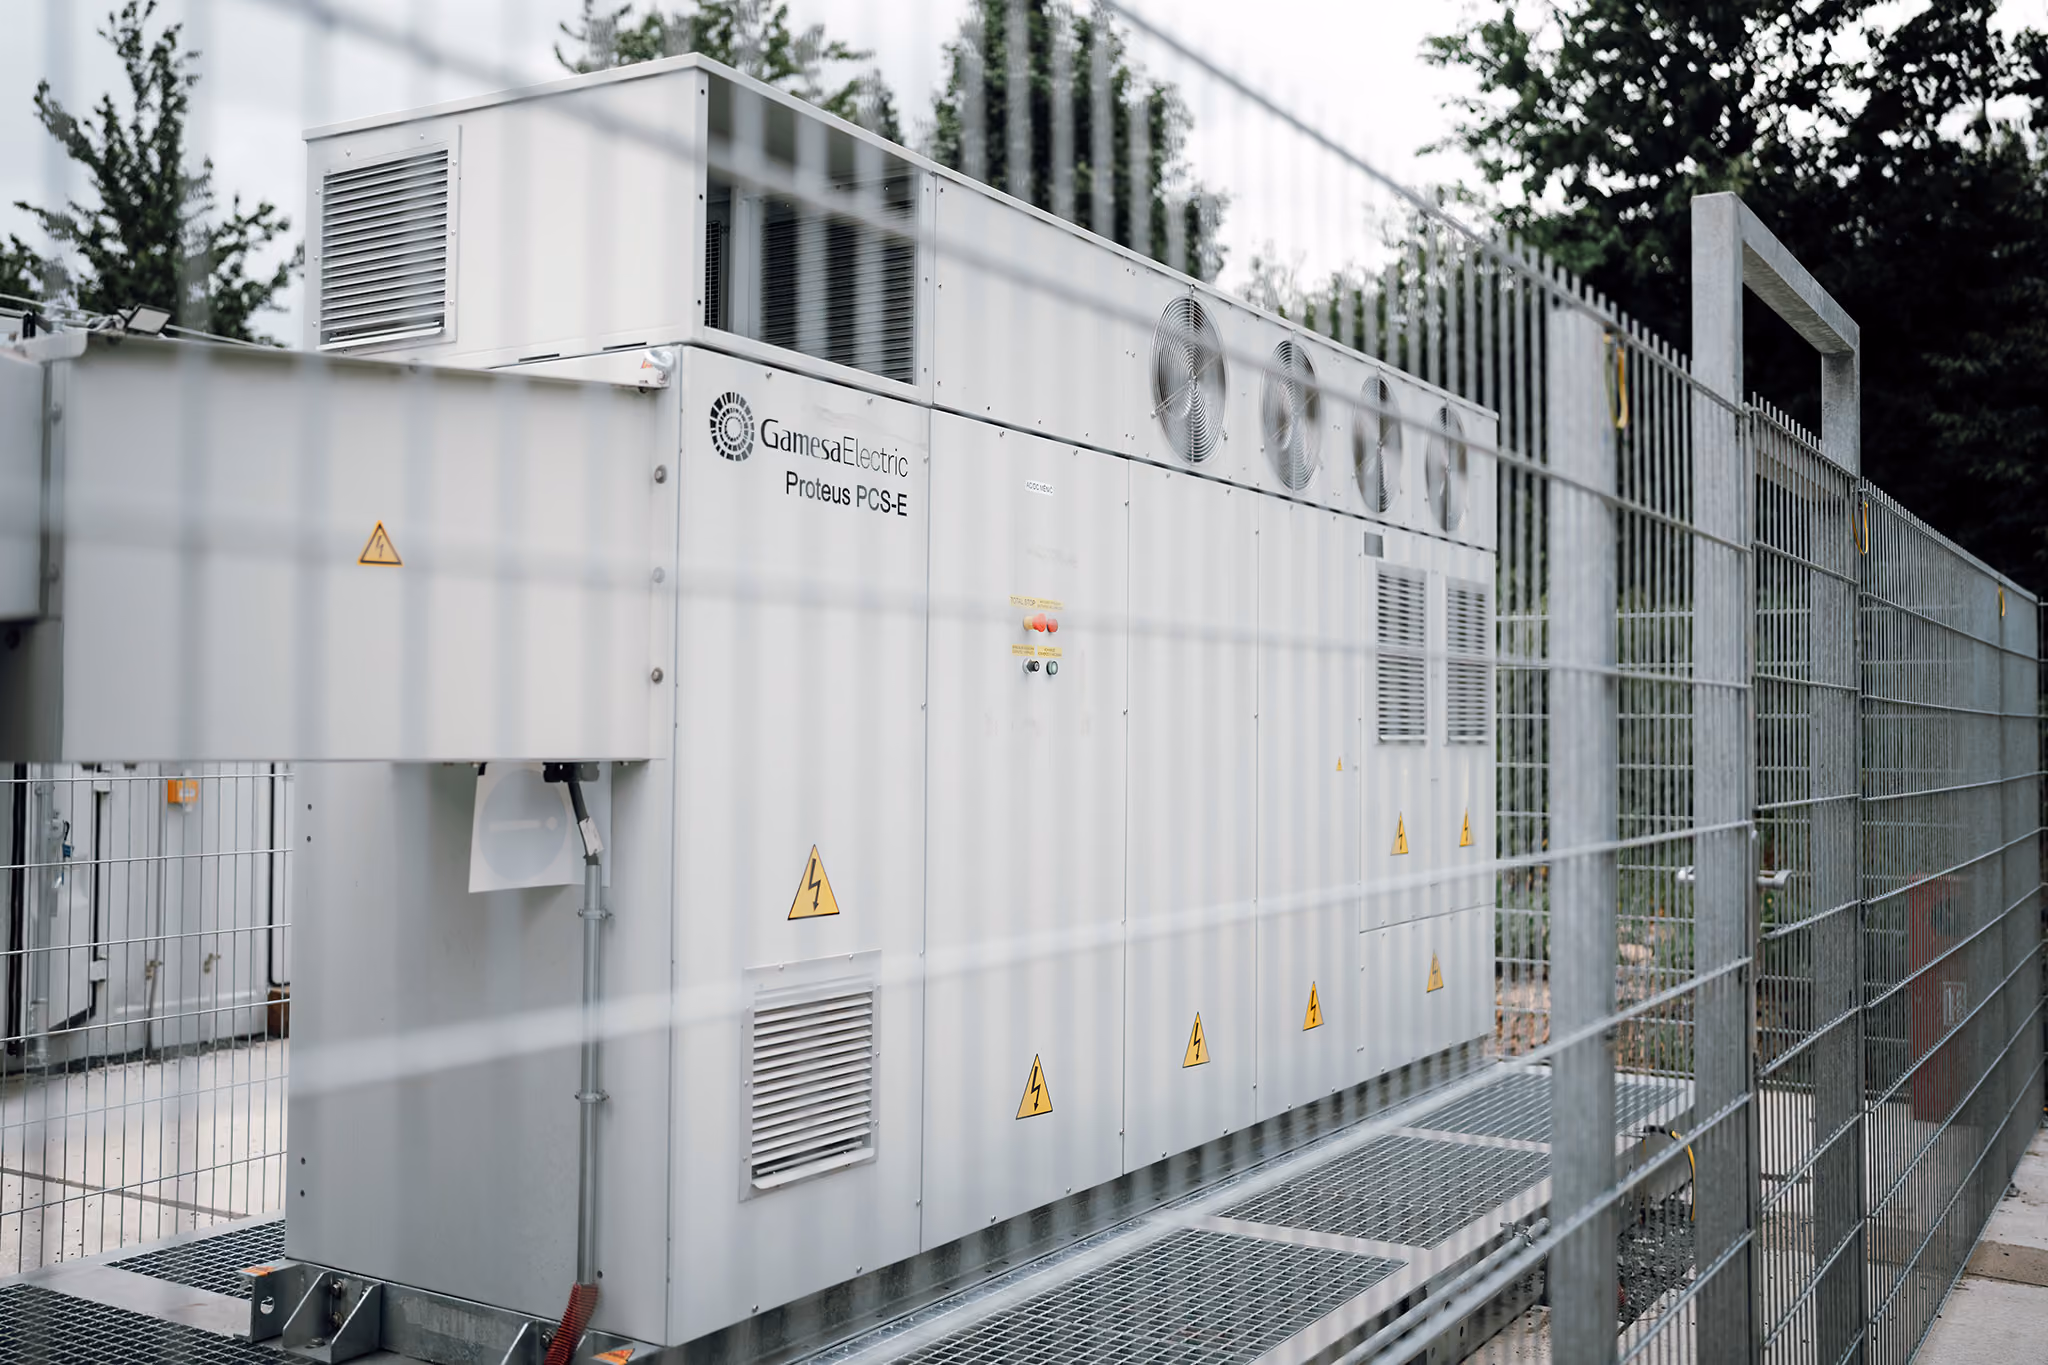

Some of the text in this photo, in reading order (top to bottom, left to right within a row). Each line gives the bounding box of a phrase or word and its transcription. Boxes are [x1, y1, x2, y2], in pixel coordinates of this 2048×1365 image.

[760, 418, 908, 478] GamesaElectric
[786, 470, 908, 517] Proteus PCS-E
